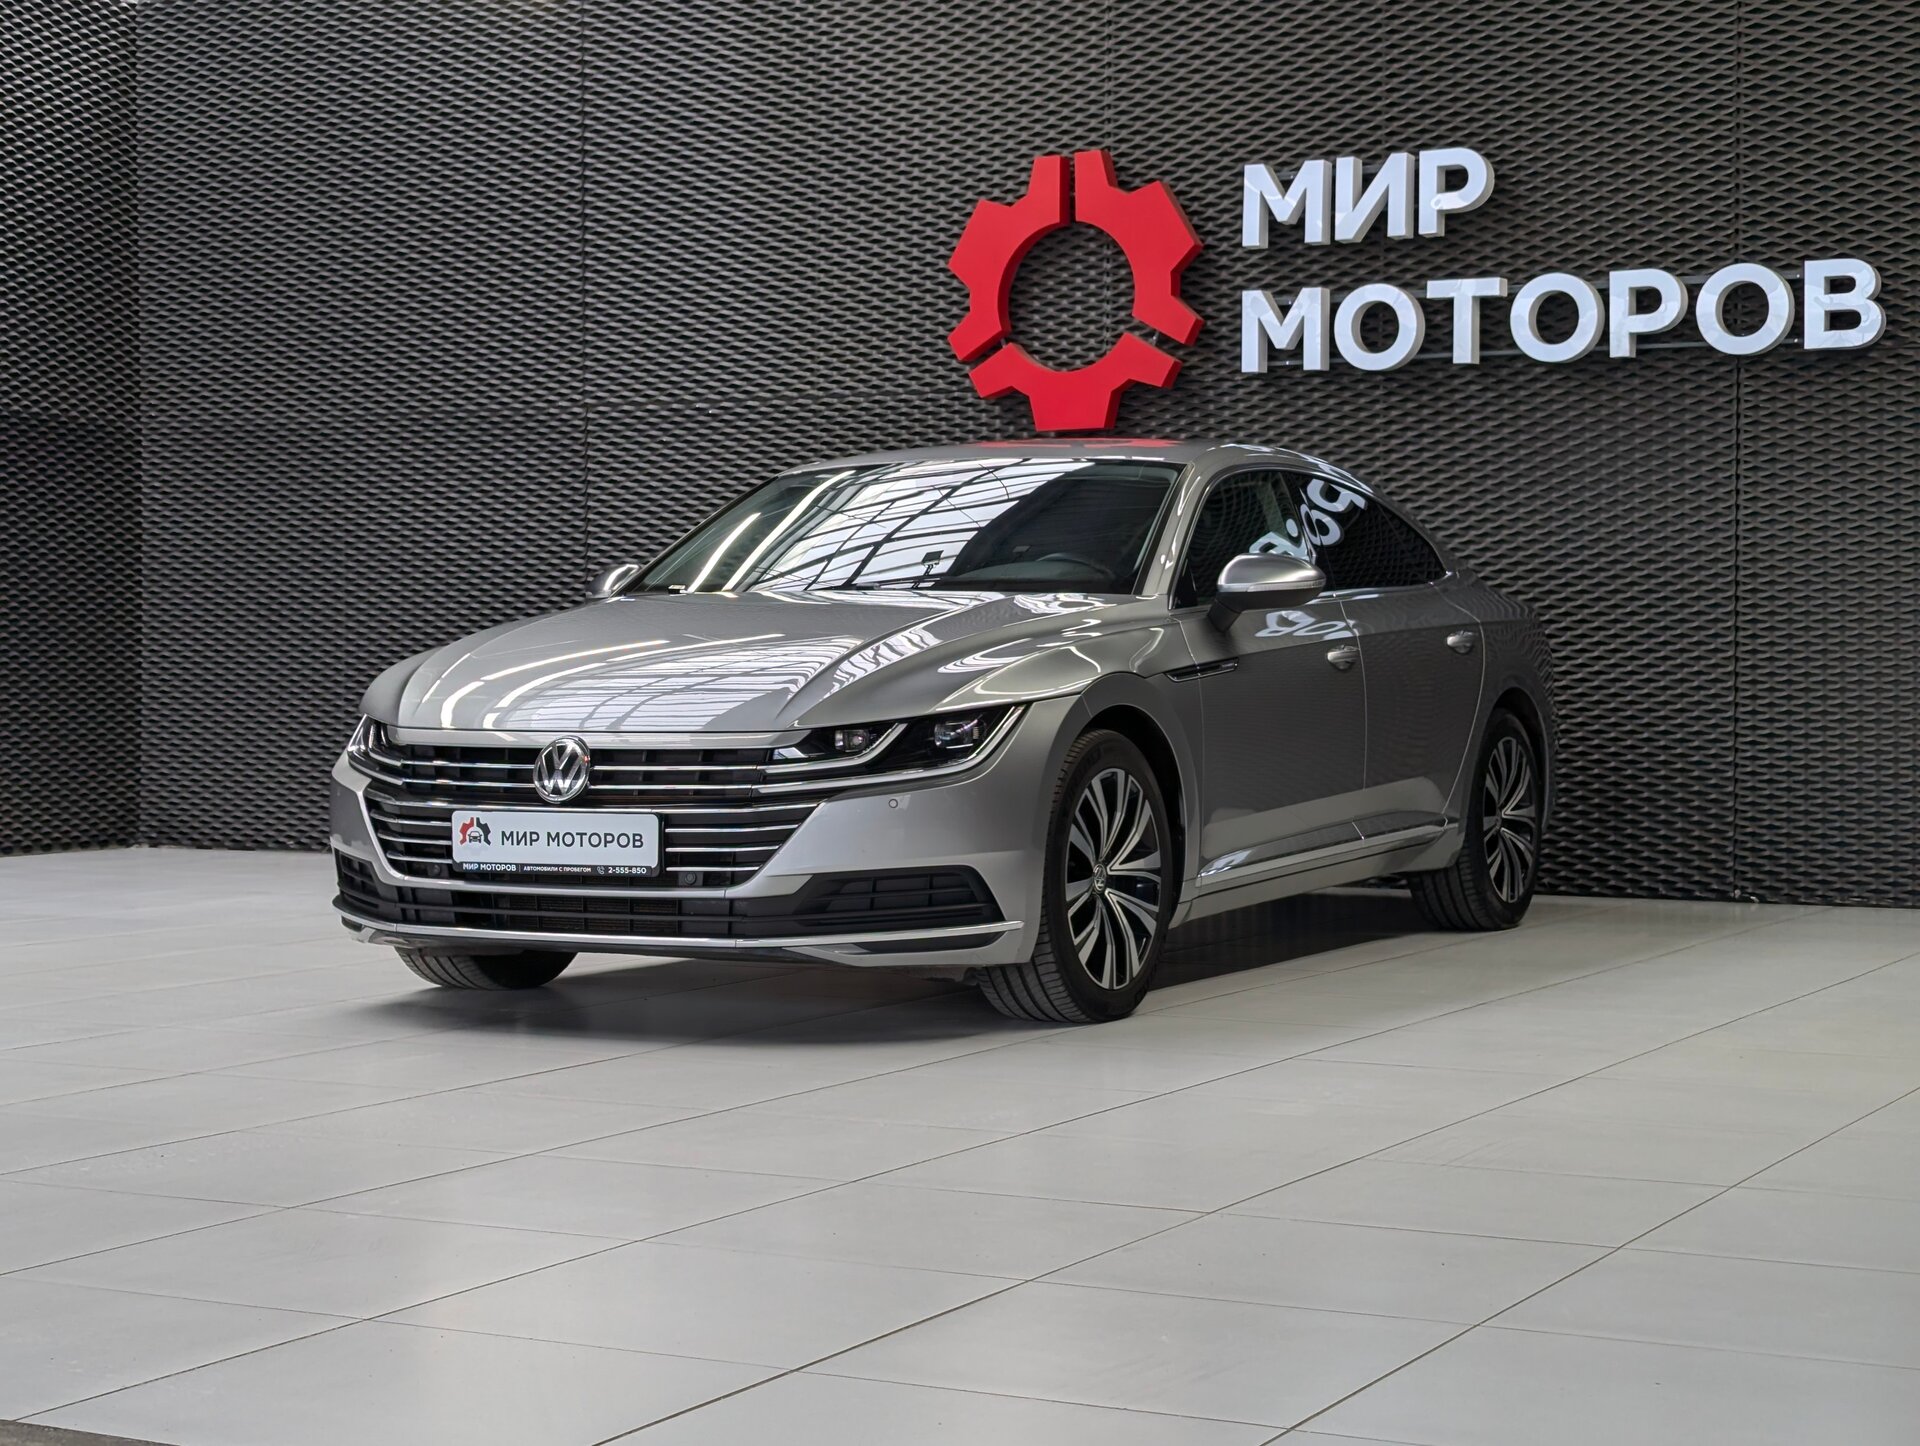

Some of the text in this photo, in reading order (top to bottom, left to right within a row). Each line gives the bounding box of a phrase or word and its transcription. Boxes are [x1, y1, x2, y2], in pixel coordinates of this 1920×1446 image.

[1242, 147, 1495, 249] МИР
[1241, 258, 1886, 374] МОТОРОВ
[501, 830, 644, 849] МИР МОТОРОВ
[480, 863, 516, 872] МОТОРОВ
[608, 866, 647, 874] 2-555-850
